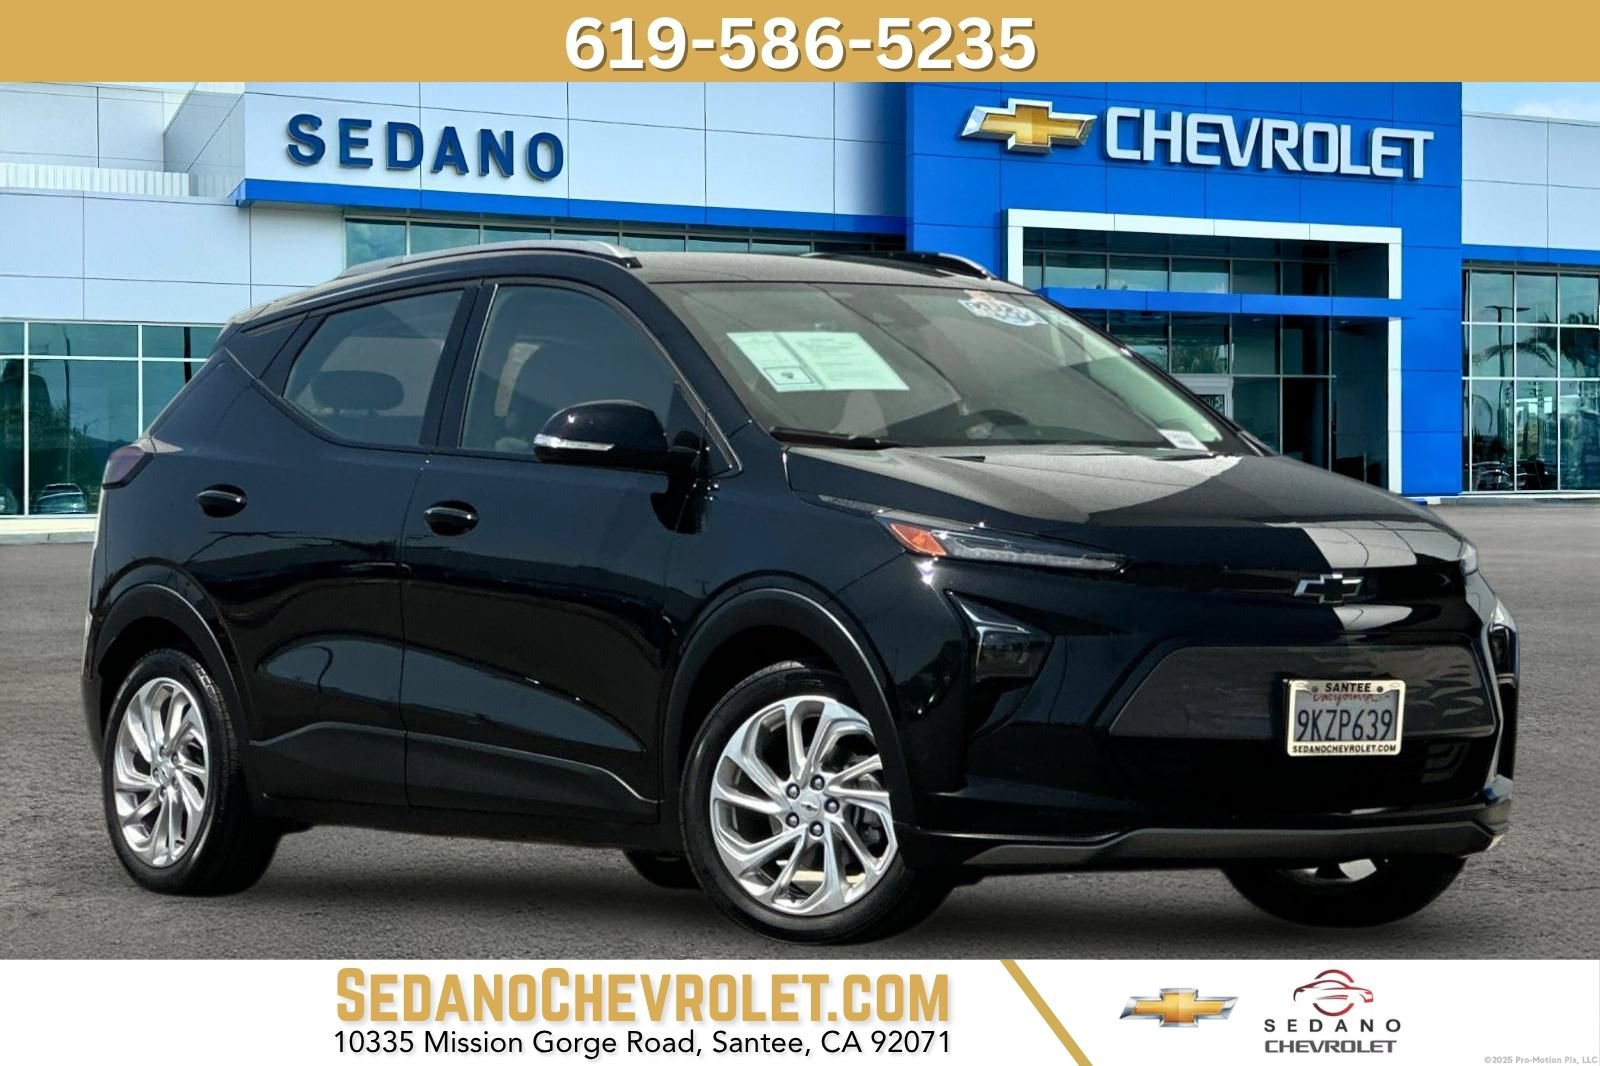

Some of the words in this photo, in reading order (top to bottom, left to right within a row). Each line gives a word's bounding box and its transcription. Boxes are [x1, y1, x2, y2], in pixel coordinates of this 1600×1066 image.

[287, 113, 564, 182] SEDANO
[1106, 106, 1435, 179] CHEVROLET
[1325, 683, 1371, 692] SANTEE
[1296, 709, 1393, 741] 9KZP639
[1292, 744, 1396, 753] SEDANOCHEVROLET.COM
